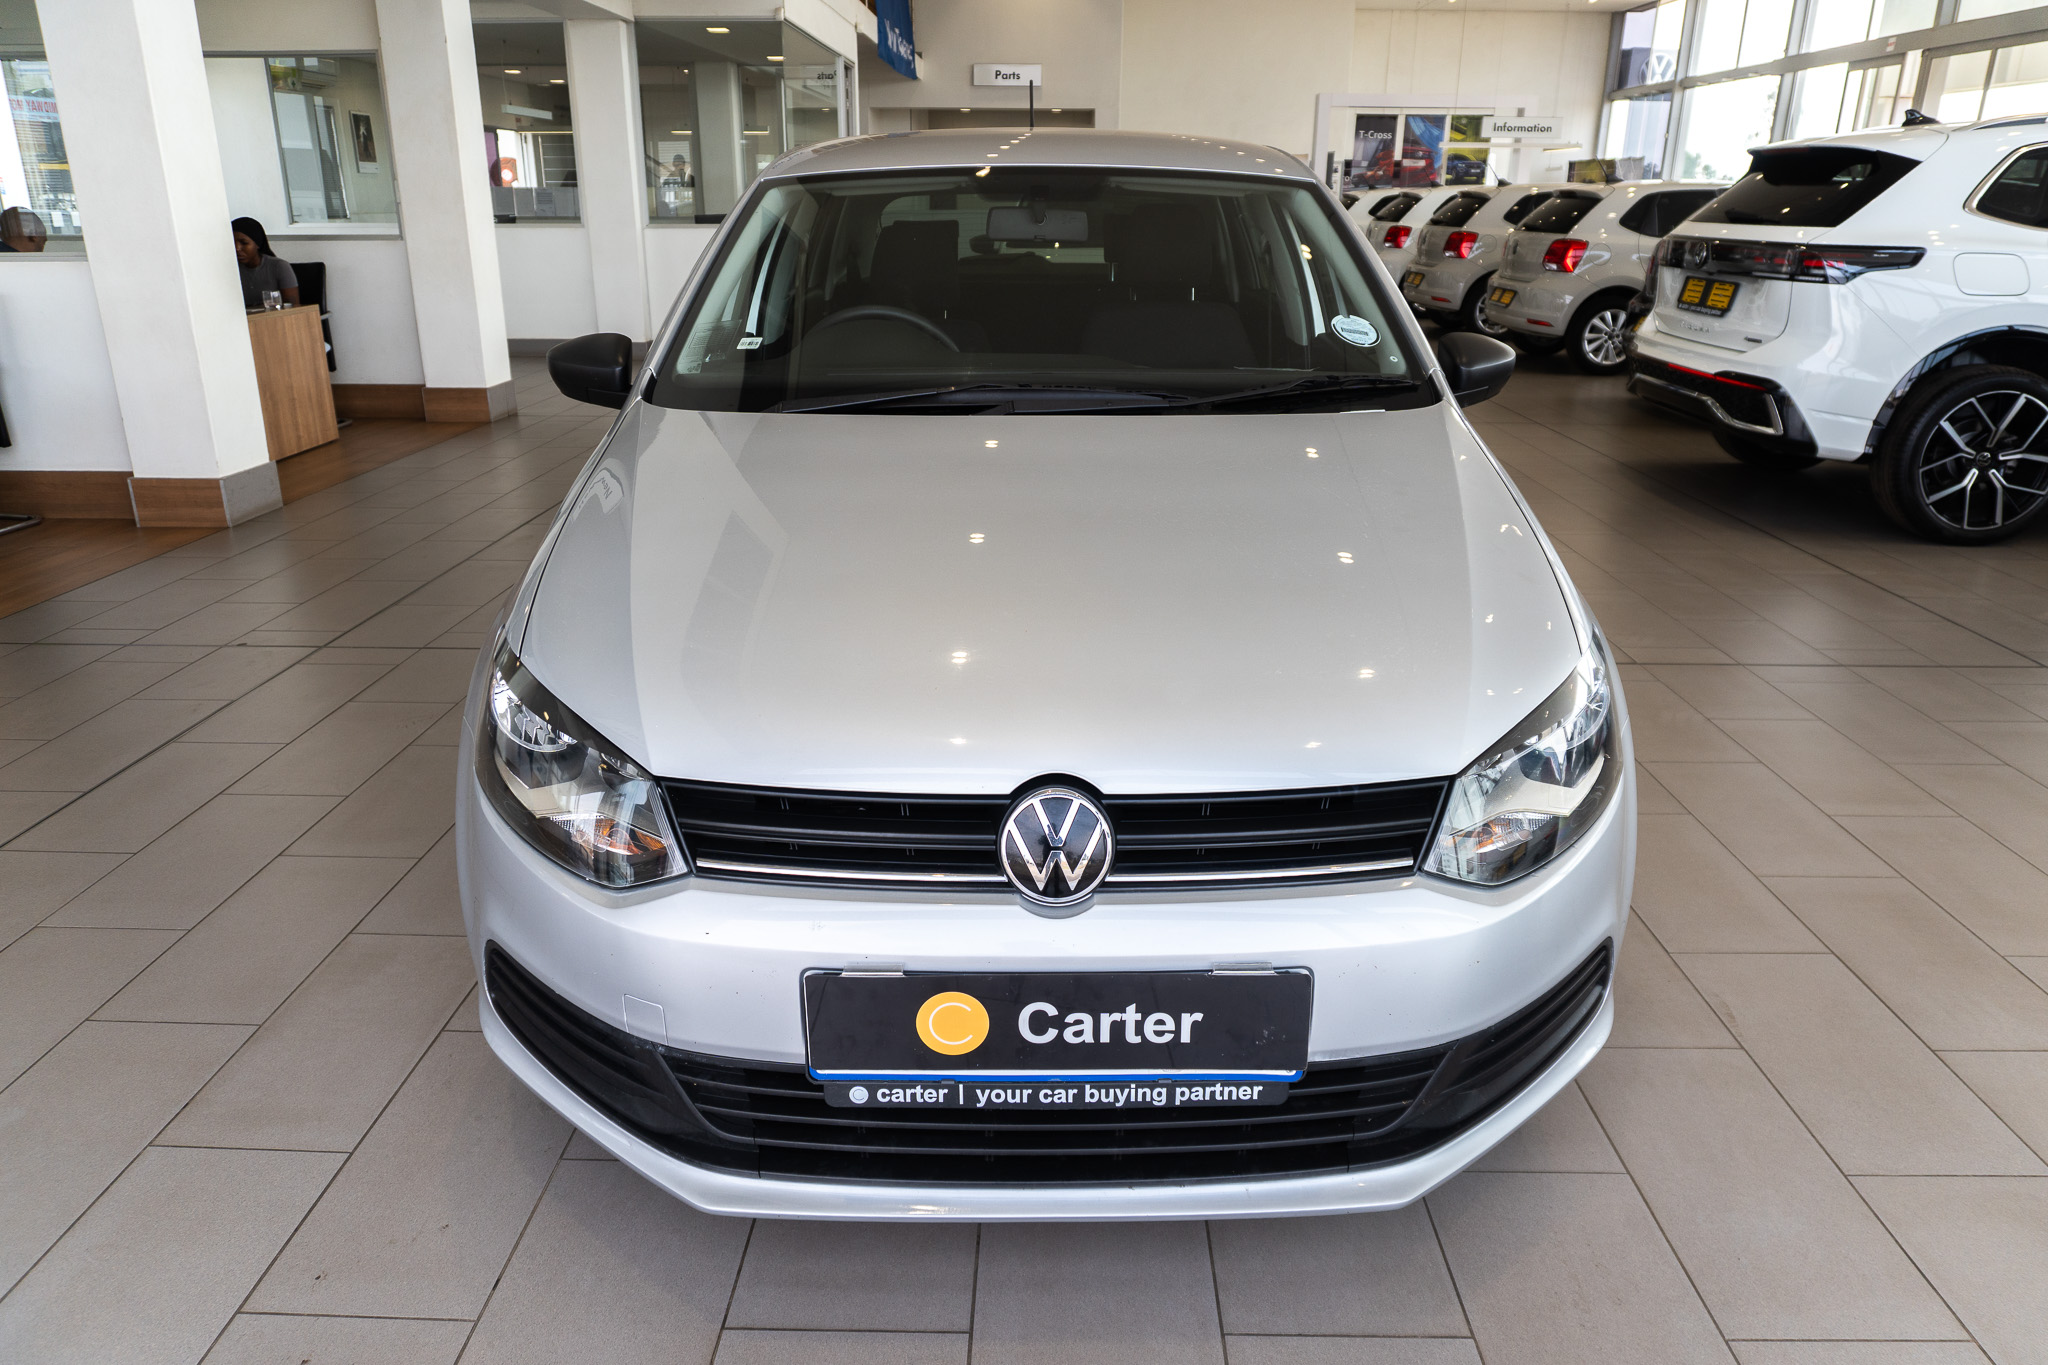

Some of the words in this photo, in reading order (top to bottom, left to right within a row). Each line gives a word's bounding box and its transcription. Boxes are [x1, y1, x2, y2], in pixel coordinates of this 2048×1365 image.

[995, 70, 1021, 80] Parts
[1493, 121, 1552, 133] Information
[1359, 130, 1393, 139] T-Cross
[1017, 1001, 1204, 1044] Carter
[876, 1085, 948, 1103] carter
[976, 1088, 1032, 1107] your
[1038, 1088, 1078, 1103] car
[1084, 1083, 1167, 1107] buying
[1175, 1083, 1263, 1106] partner
